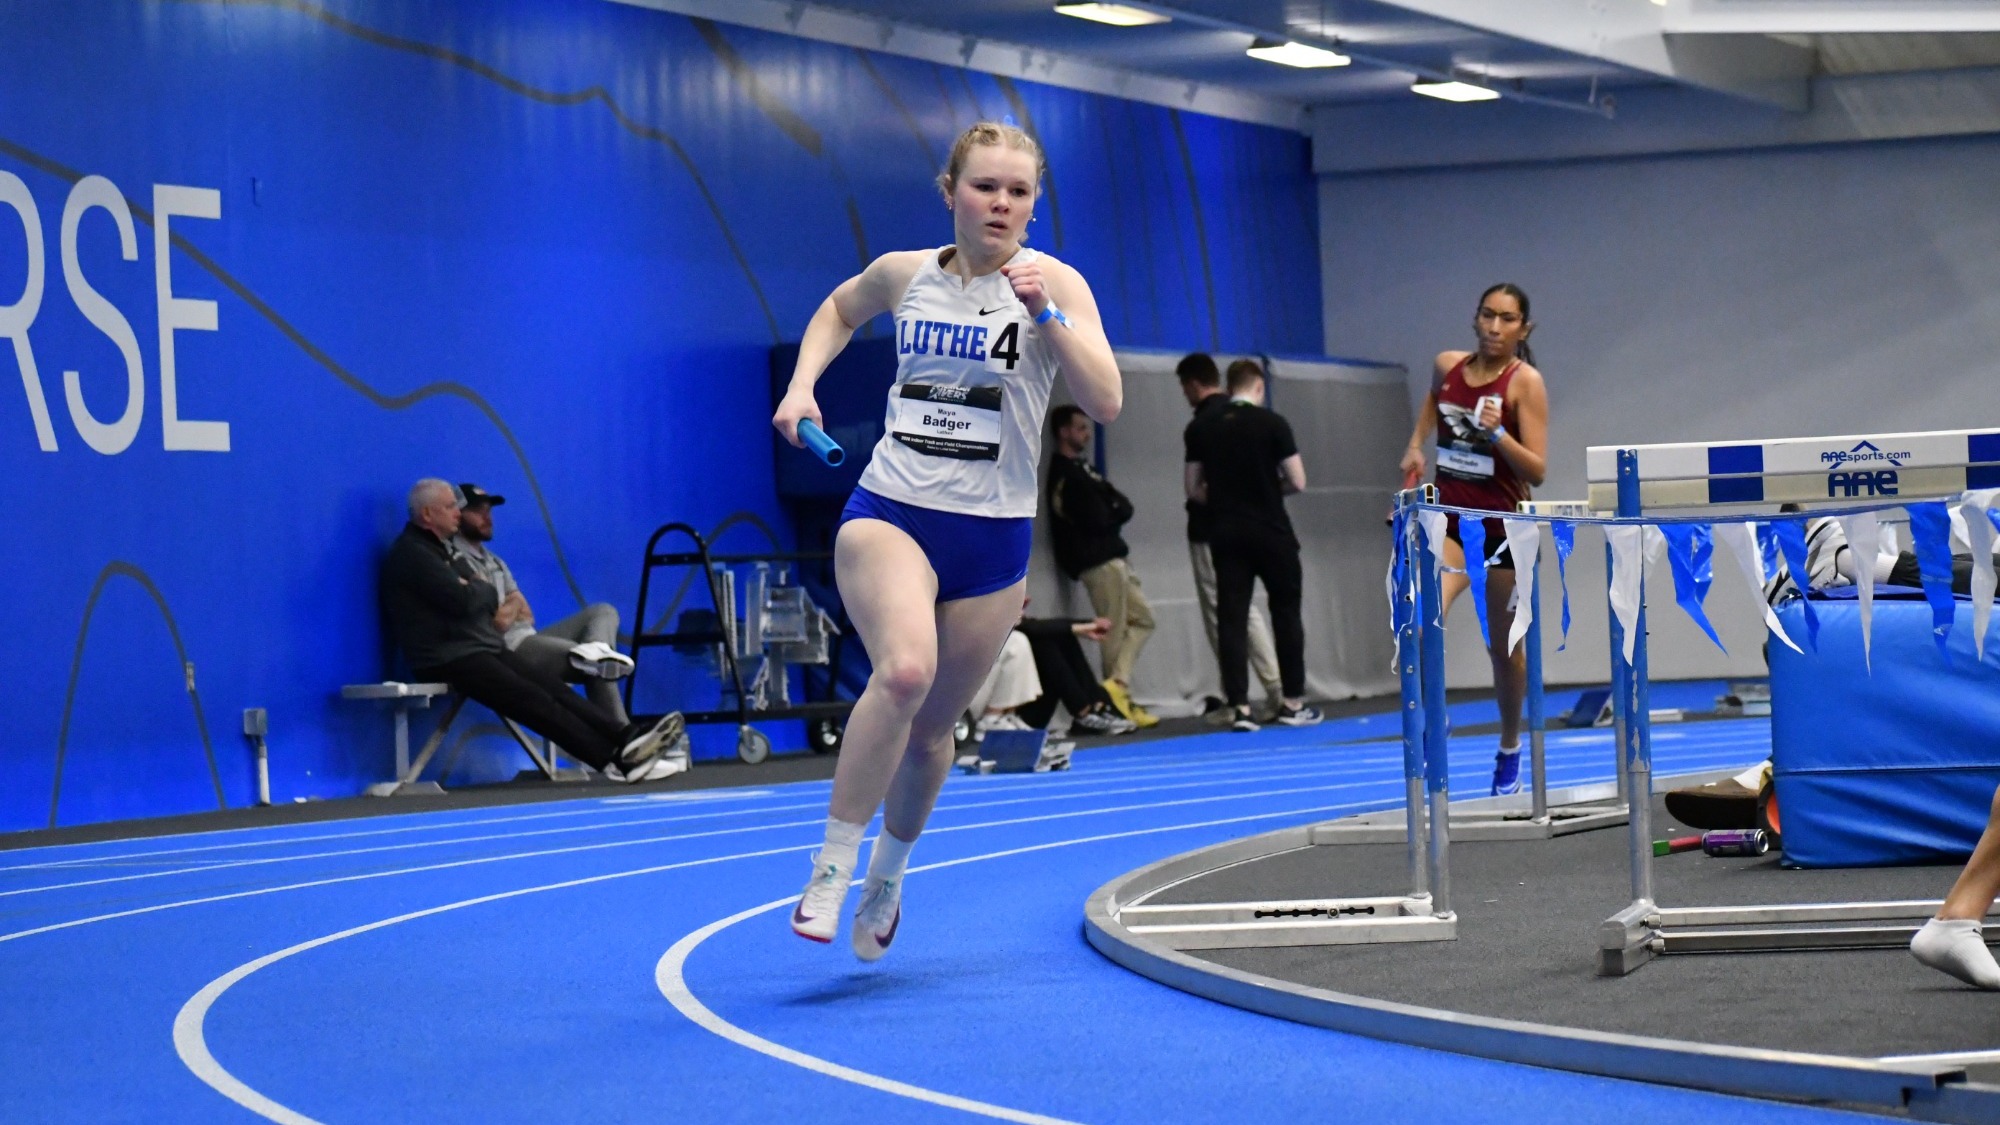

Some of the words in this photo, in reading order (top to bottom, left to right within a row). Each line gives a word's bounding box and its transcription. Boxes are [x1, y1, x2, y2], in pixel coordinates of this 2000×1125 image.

[0, 170, 230, 455] RSE
[990, 322, 1020, 370] 4
[923, 415, 971, 431] Badger
[937, 408, 956, 416] Maya
